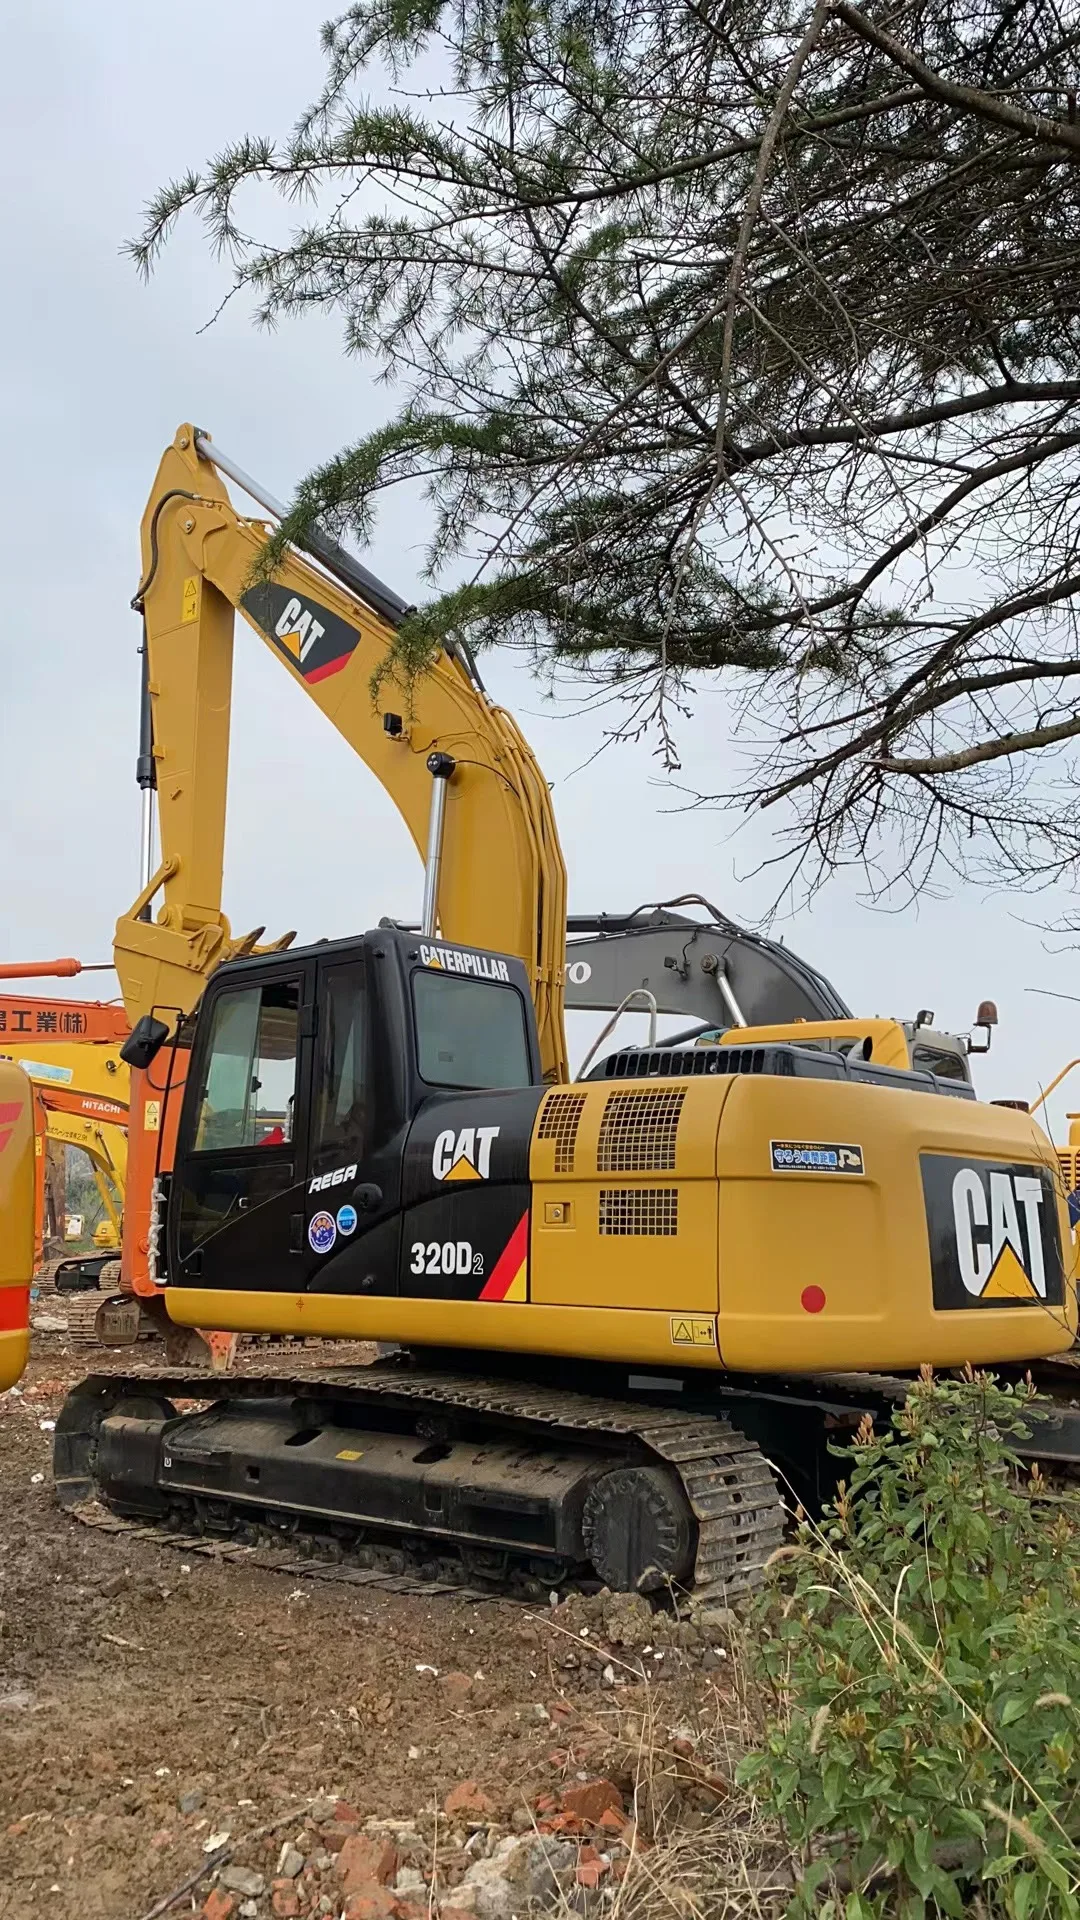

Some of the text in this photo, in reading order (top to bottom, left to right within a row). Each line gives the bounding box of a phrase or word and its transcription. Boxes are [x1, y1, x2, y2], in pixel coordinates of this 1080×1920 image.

[275, 597, 326, 663] CAT
[419, 944, 510, 982] CATERPILLAR
[82, 1100, 121, 1114] HITACHI
[432, 1126, 501, 1181] CAT
[774, 1149, 837, 1166] 守ろう車間距離
[952, 1168, 1047, 1298] CAT
